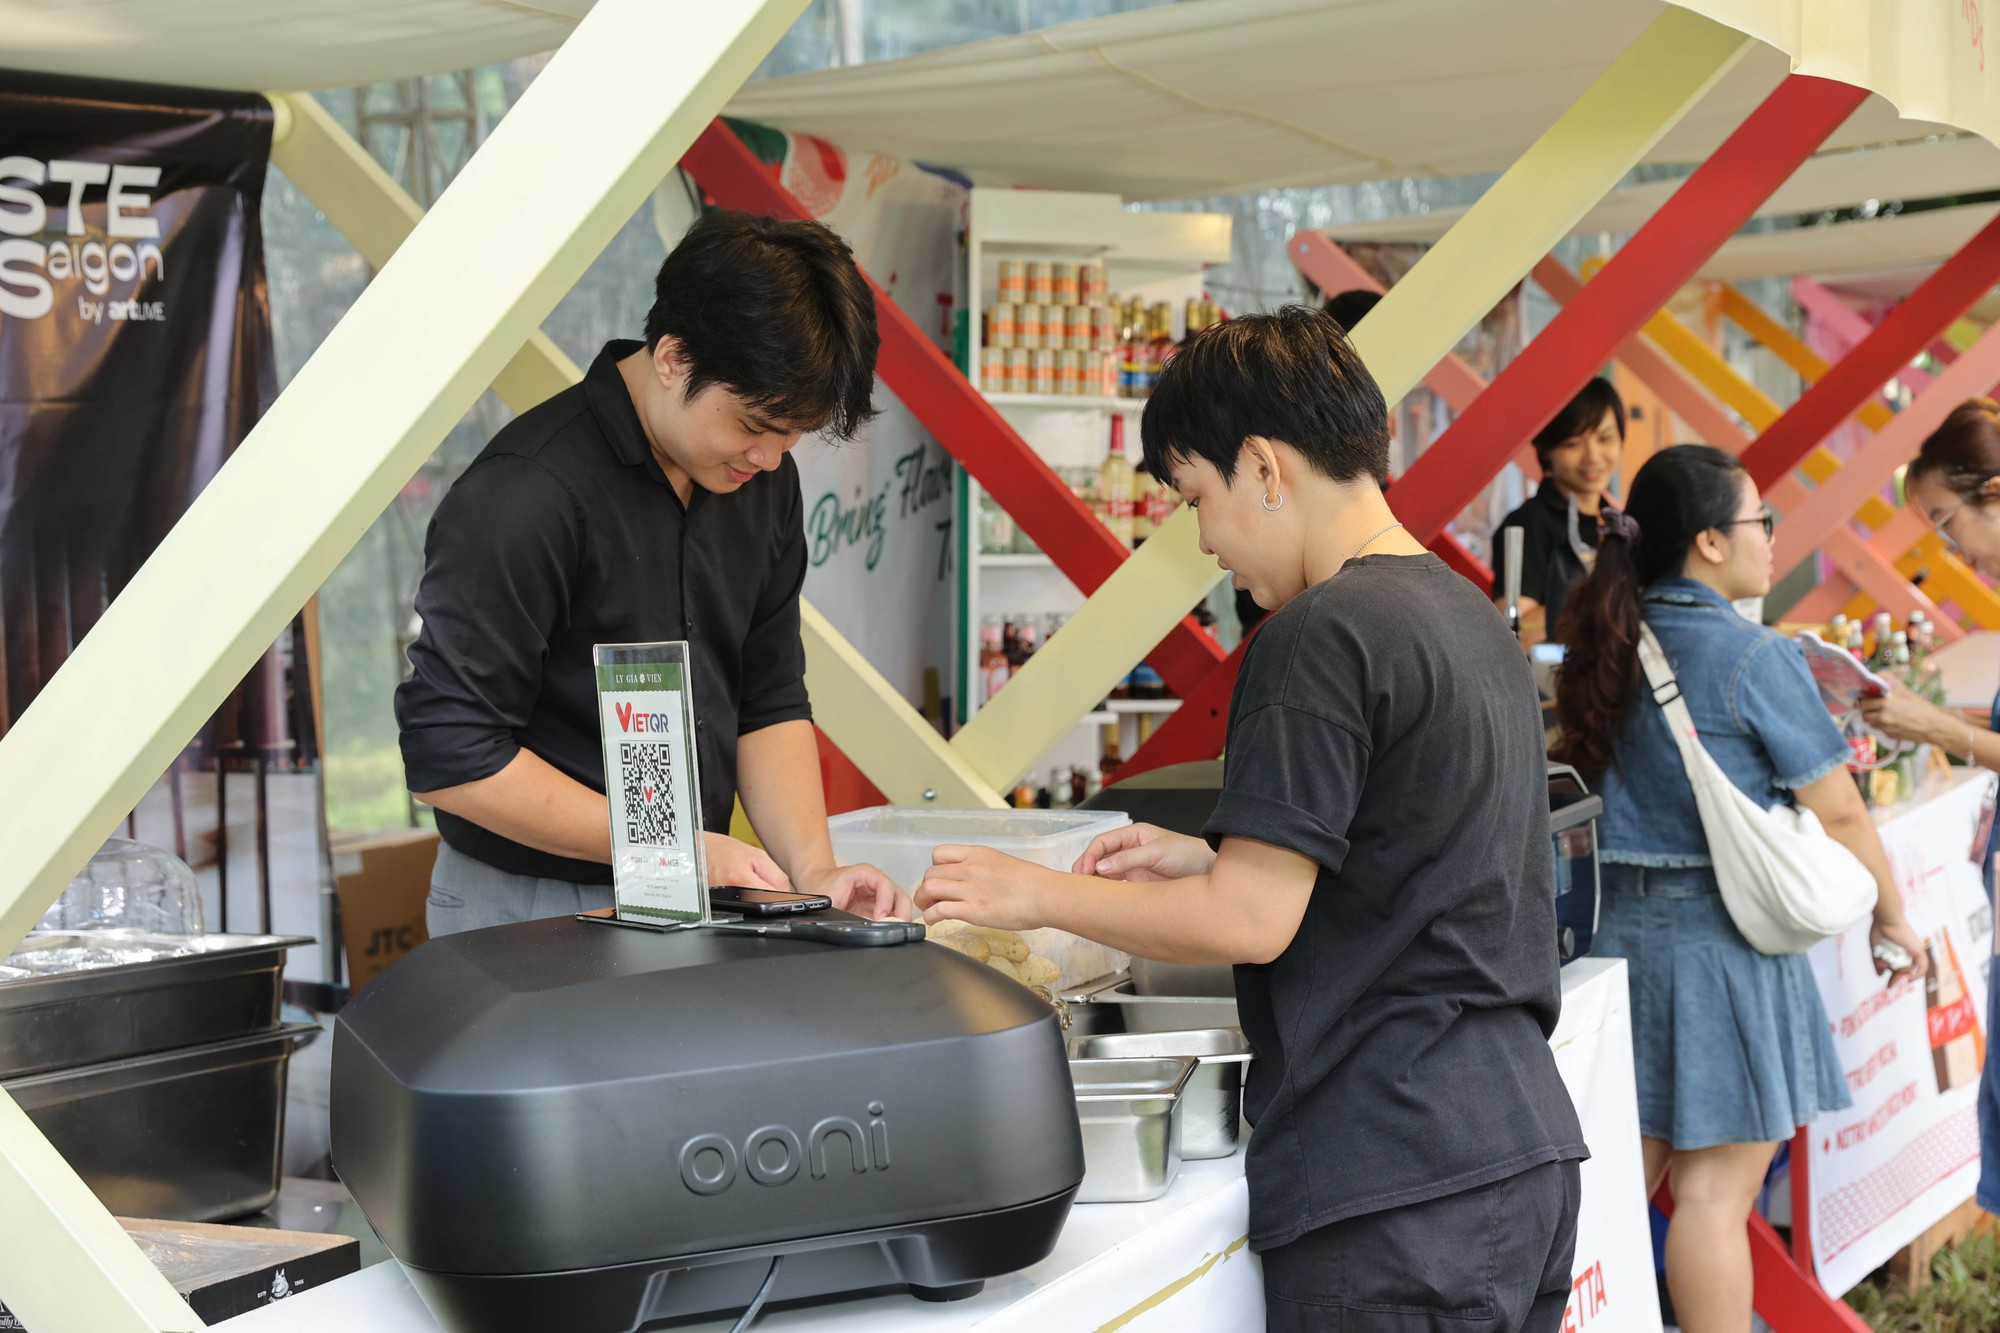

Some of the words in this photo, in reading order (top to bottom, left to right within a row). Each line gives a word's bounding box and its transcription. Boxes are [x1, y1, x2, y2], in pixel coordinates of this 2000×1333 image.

[0, 156, 162, 239] STE
[0, 238, 164, 320] Saigon
[77, 294, 105, 325] by
[615, 674, 624, 684] LY
[626, 674, 638, 683] GIA
[364, 924, 414, 958] JTC
[679, 1100, 890, 1197] ooni
